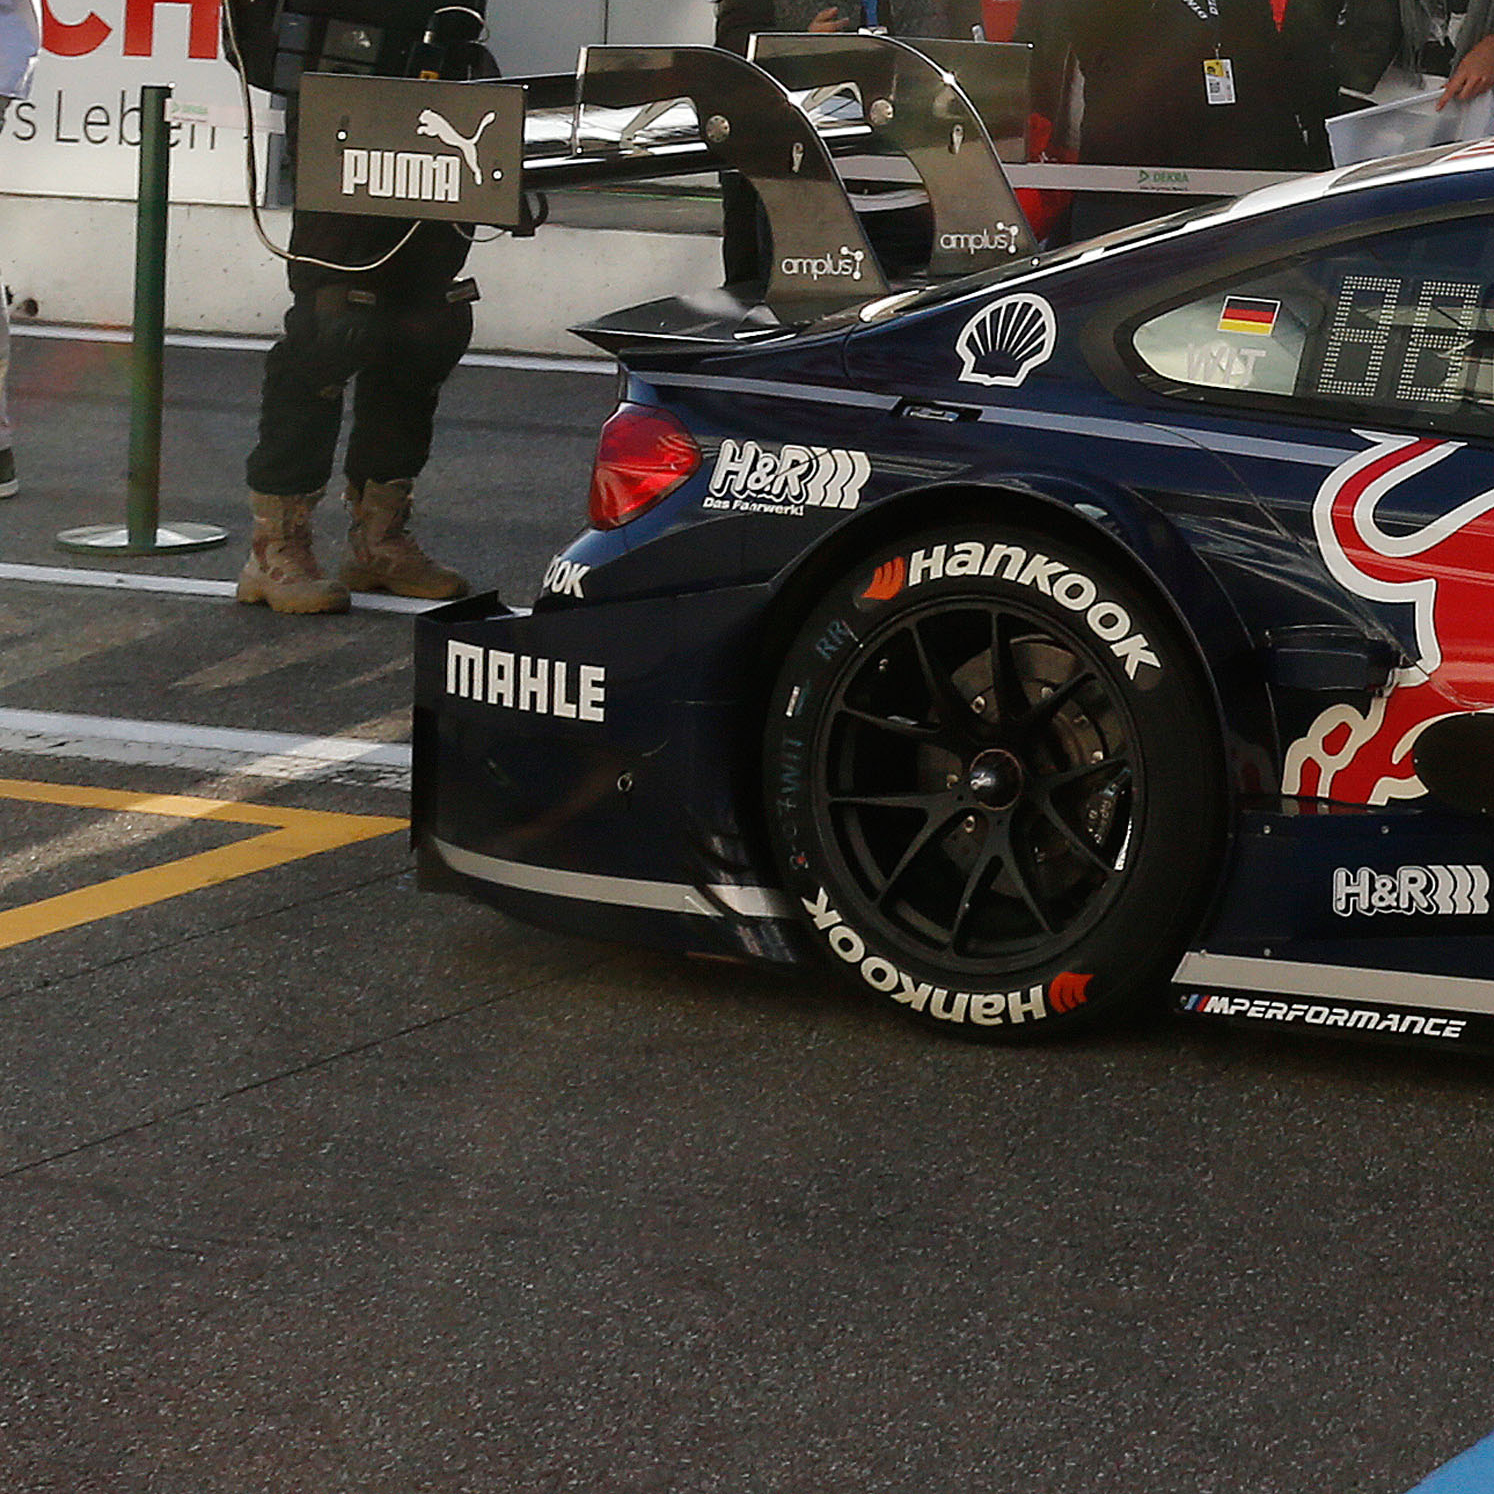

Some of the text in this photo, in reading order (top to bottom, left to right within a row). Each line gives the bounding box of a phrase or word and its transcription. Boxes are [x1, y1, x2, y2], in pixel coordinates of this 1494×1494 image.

[341, 148, 461, 203] PUMA
[940, 228, 1008, 255] amplus
[781, 253, 853, 281] amplus
[709, 439, 815, 504] H&R
[702, 496, 730, 511] Das
[446, 639, 606, 723] MAHLE
[1333, 867, 1437, 917] H&R
